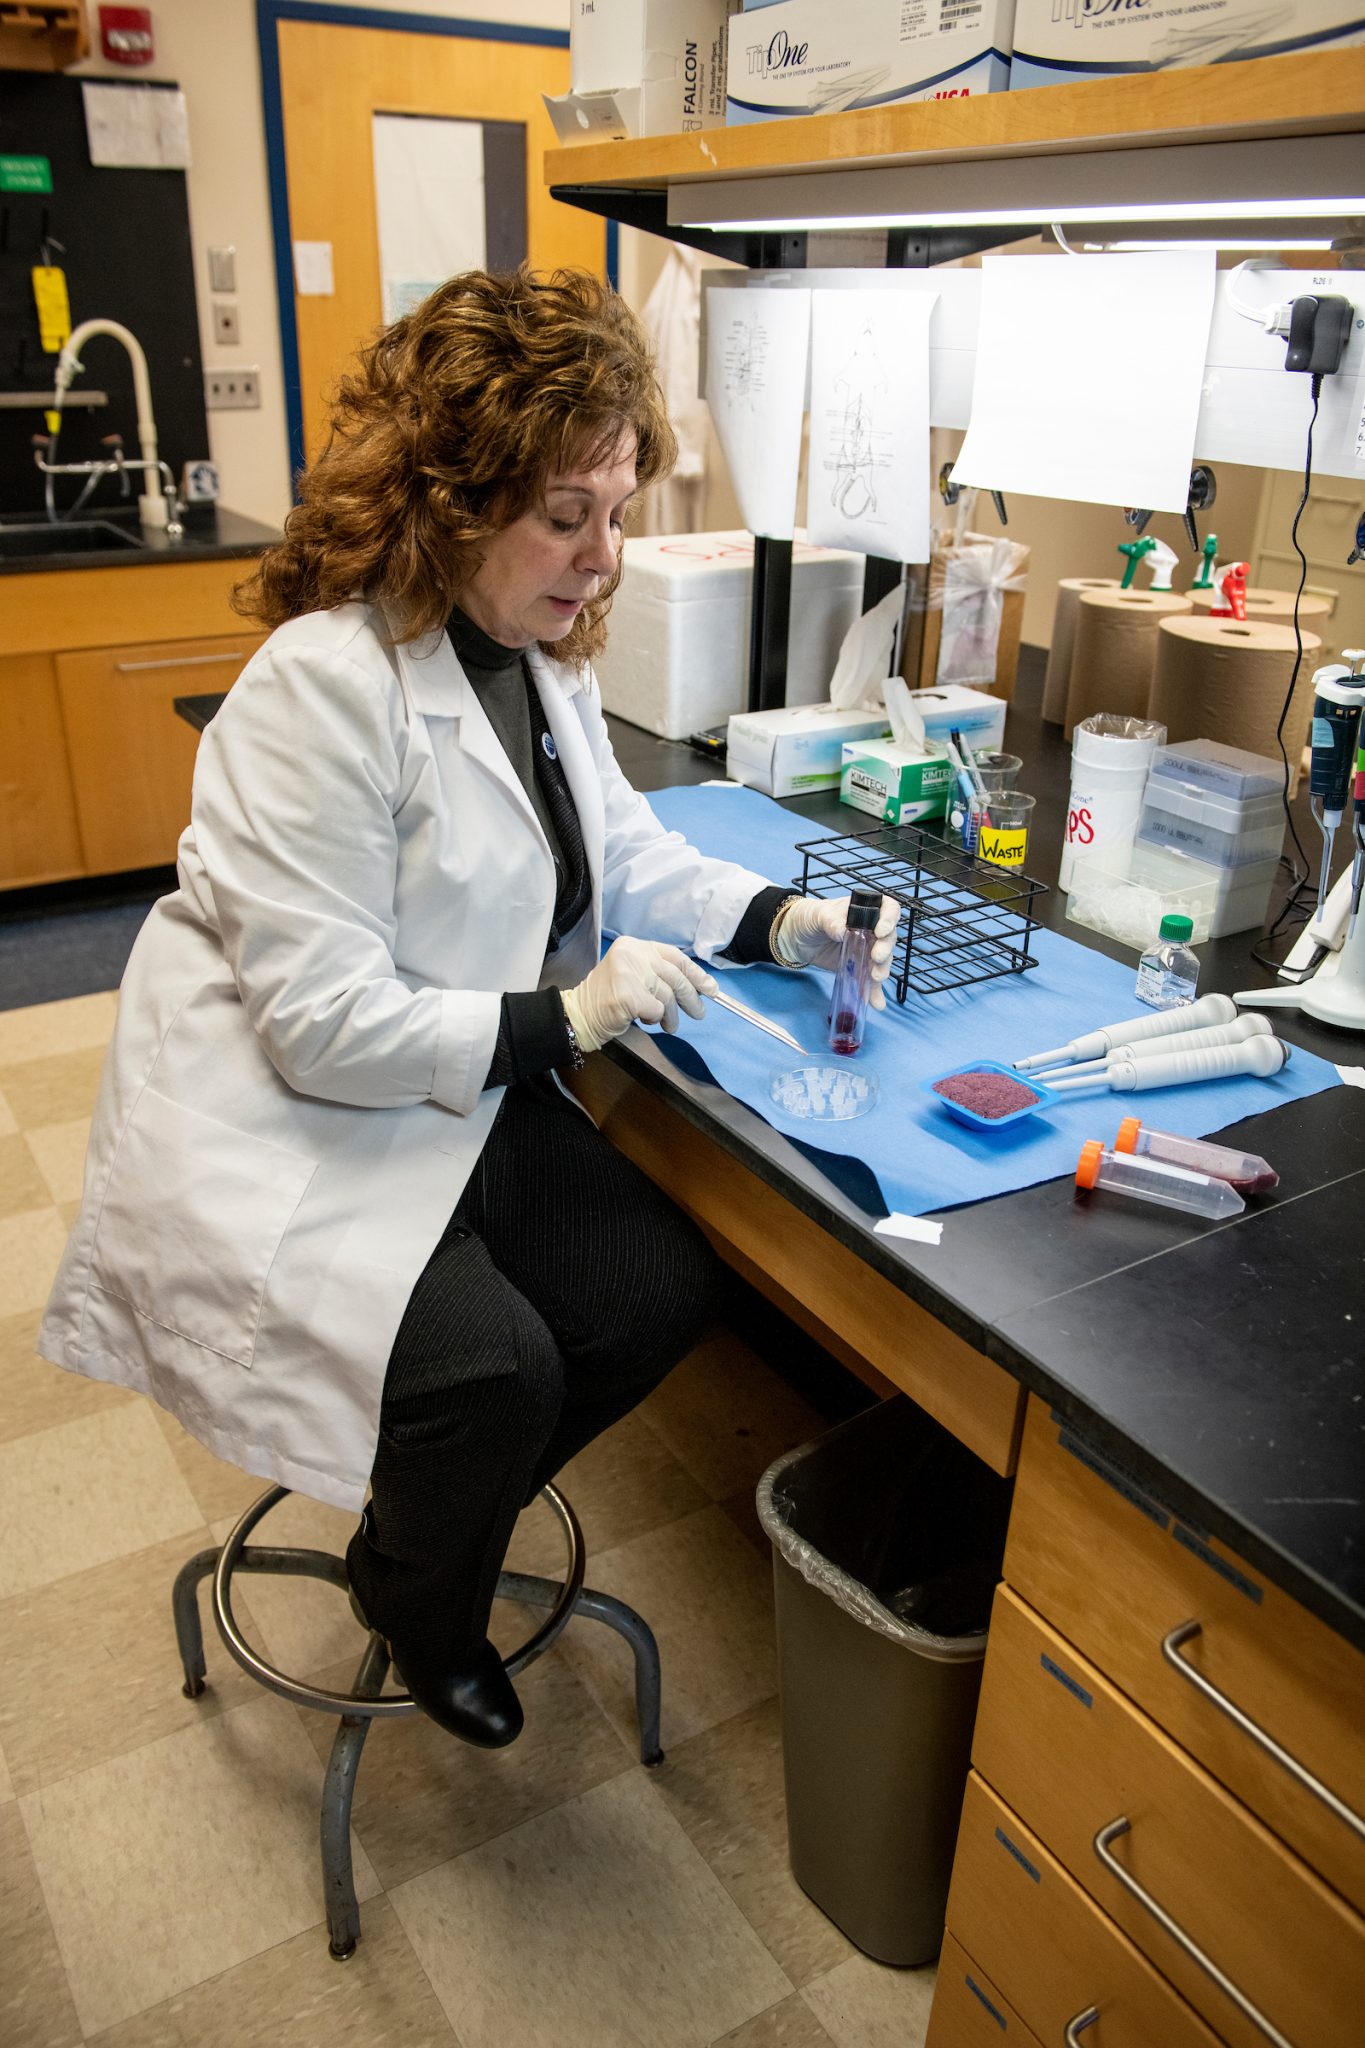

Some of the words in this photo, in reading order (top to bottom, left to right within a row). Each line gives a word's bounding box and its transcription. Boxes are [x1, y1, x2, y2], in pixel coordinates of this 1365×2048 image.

[581, 3, 585, 15] 3
[586, 1, 595, 14] mL
[1092, 21, 1103, 30] THE
[1104, 19, 1116, 28] ONE
[1117, 18, 1127, 26] TIP
[1126, 15, 1151, 25] SYSTEM
[1151, 12, 1164, 21] FOR
[1165, 8, 1183, 18] YOUR
[683, 42, 698, 114] FALCON
[793, 70, 807, 78] SYSTEM
[815, 66, 826, 74] YOUR
[825, 61, 851, 72] LABORATORY
[851, 770, 887, 793] KIMTECH
[981, 835, 1024, 859] WASTE
